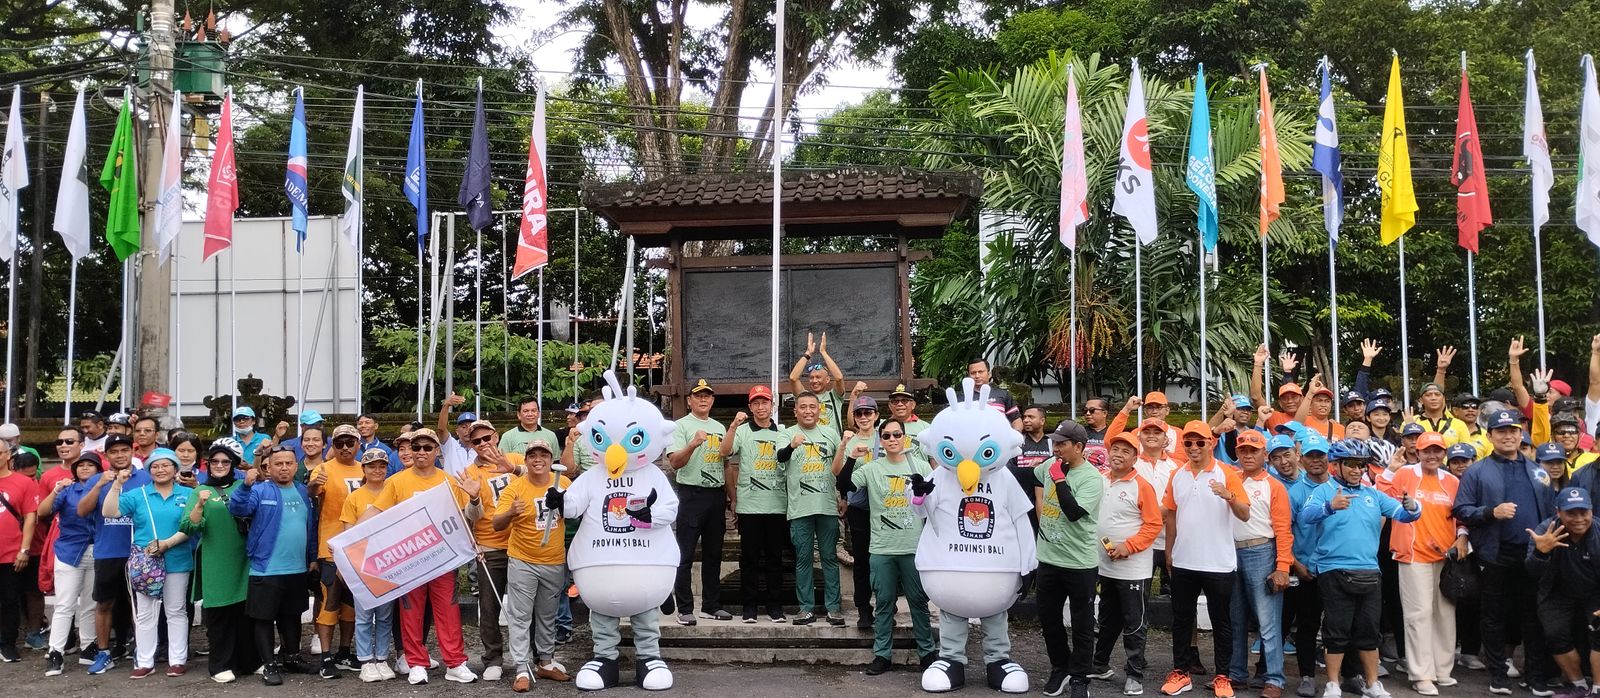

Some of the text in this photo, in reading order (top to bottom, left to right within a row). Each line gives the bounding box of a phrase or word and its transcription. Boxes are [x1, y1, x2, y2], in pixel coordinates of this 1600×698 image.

[606, 477, 633, 489] SULU
[964, 497, 991, 505] KOMISI
[104, 516, 133, 524] DEMOKRA
[592, 538, 650, 548] PROVINSI BALI
[948, 543, 1005, 555] PROVINSI BALI
